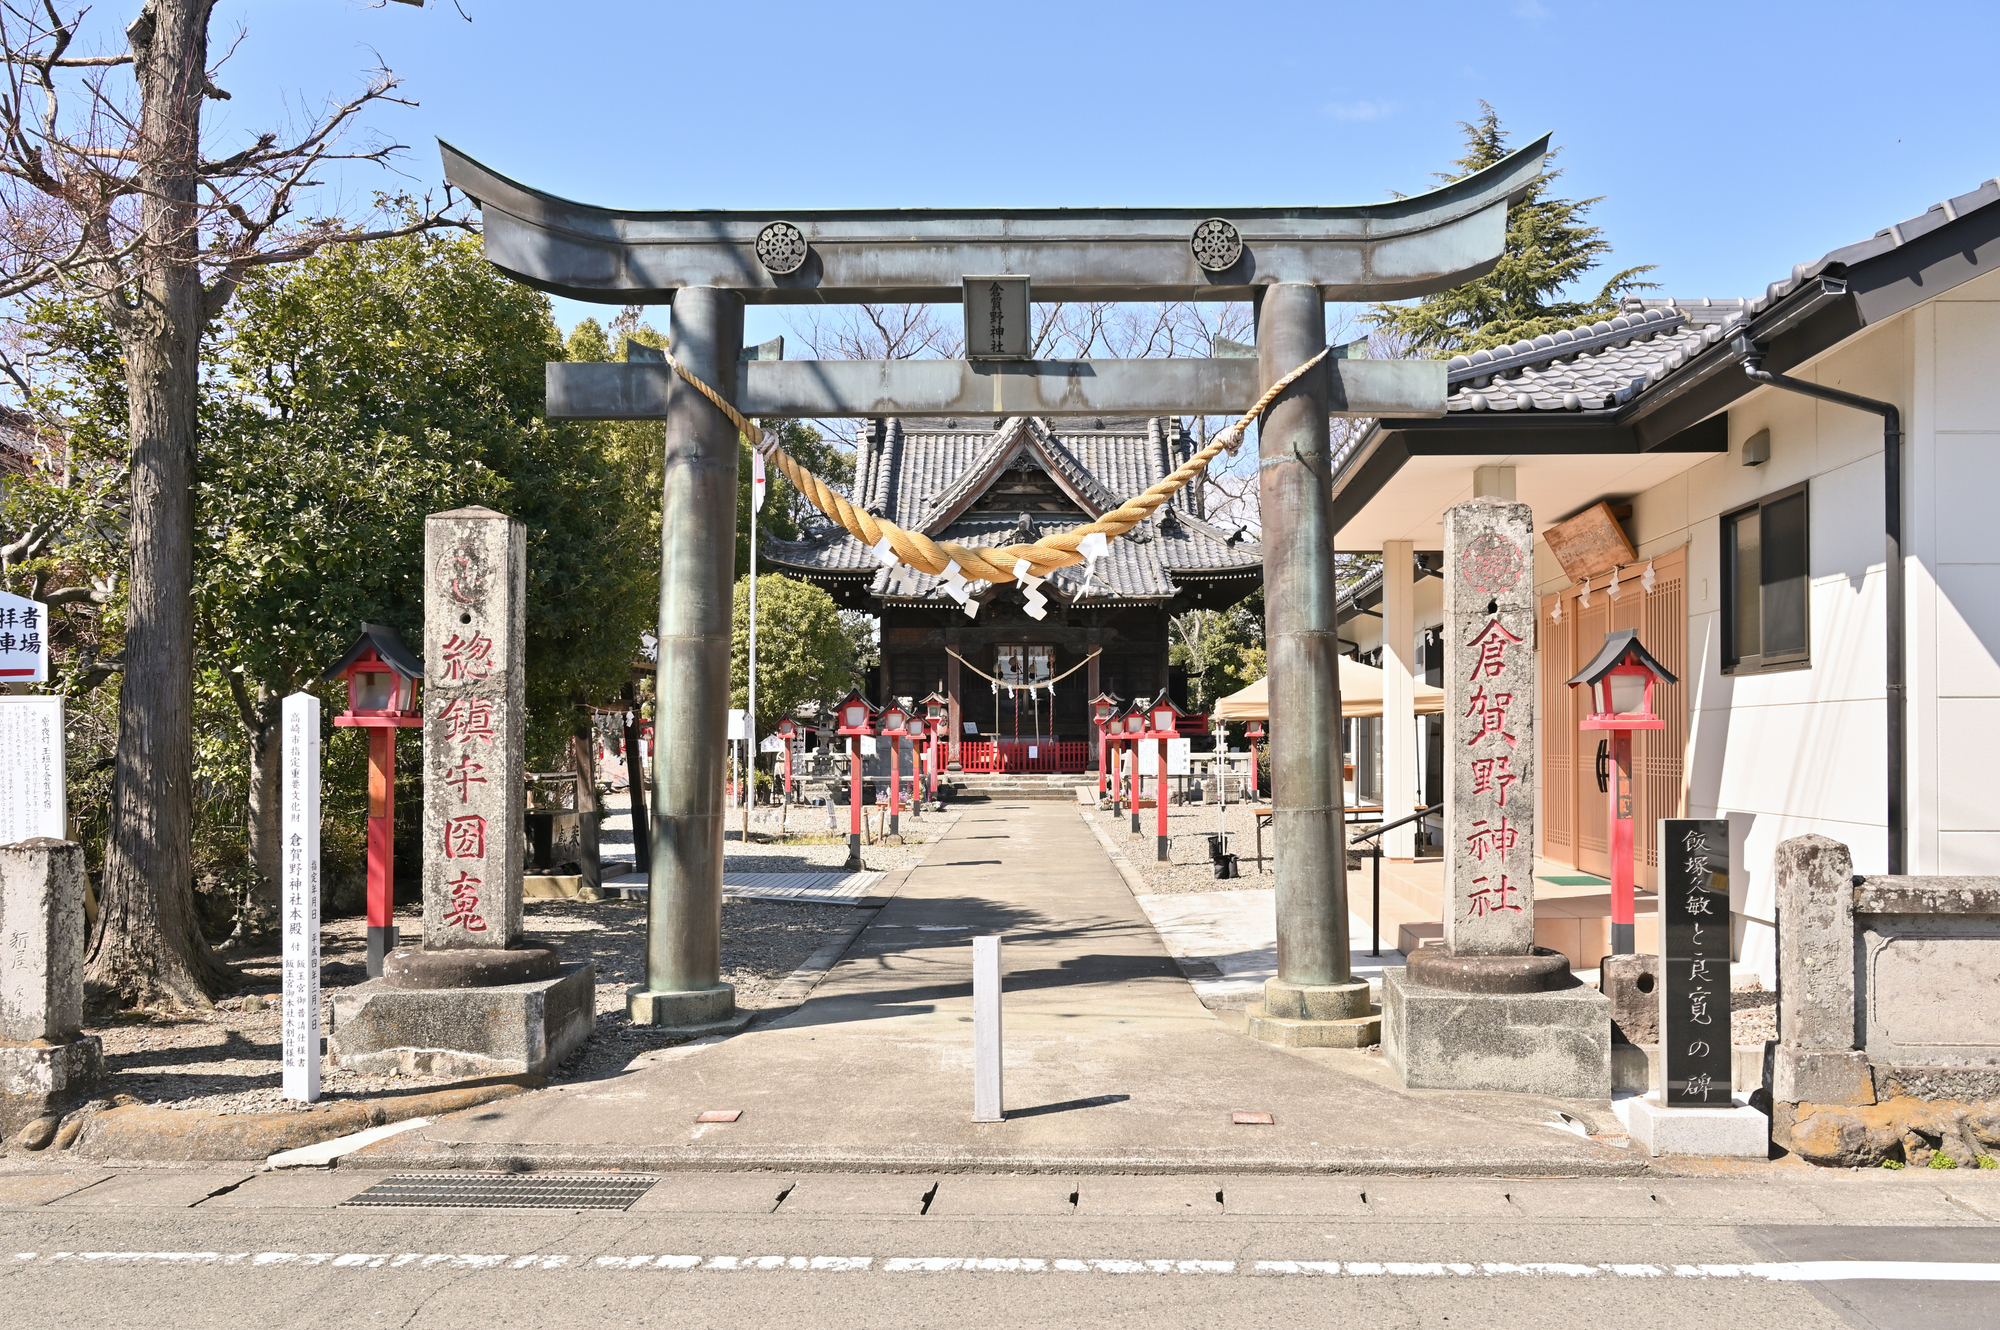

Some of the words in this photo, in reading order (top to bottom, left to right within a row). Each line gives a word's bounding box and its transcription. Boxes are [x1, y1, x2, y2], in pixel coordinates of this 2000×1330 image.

[989, 281, 1005, 353] 倉賀野神社
[0, 606, 41, 629] 拝者
[0, 632, 42, 655] 車場
[290, 712, 301, 823] 高崎市指定重要文化財
[1465, 618, 1524, 917] 倉賀野神社
[288, 832, 303, 935] 倉賀野神社本殿
[310, 860, 318, 919] 指定年月日
[1681, 829, 1714, 1102] 飯塚久敏と良寛の碑
